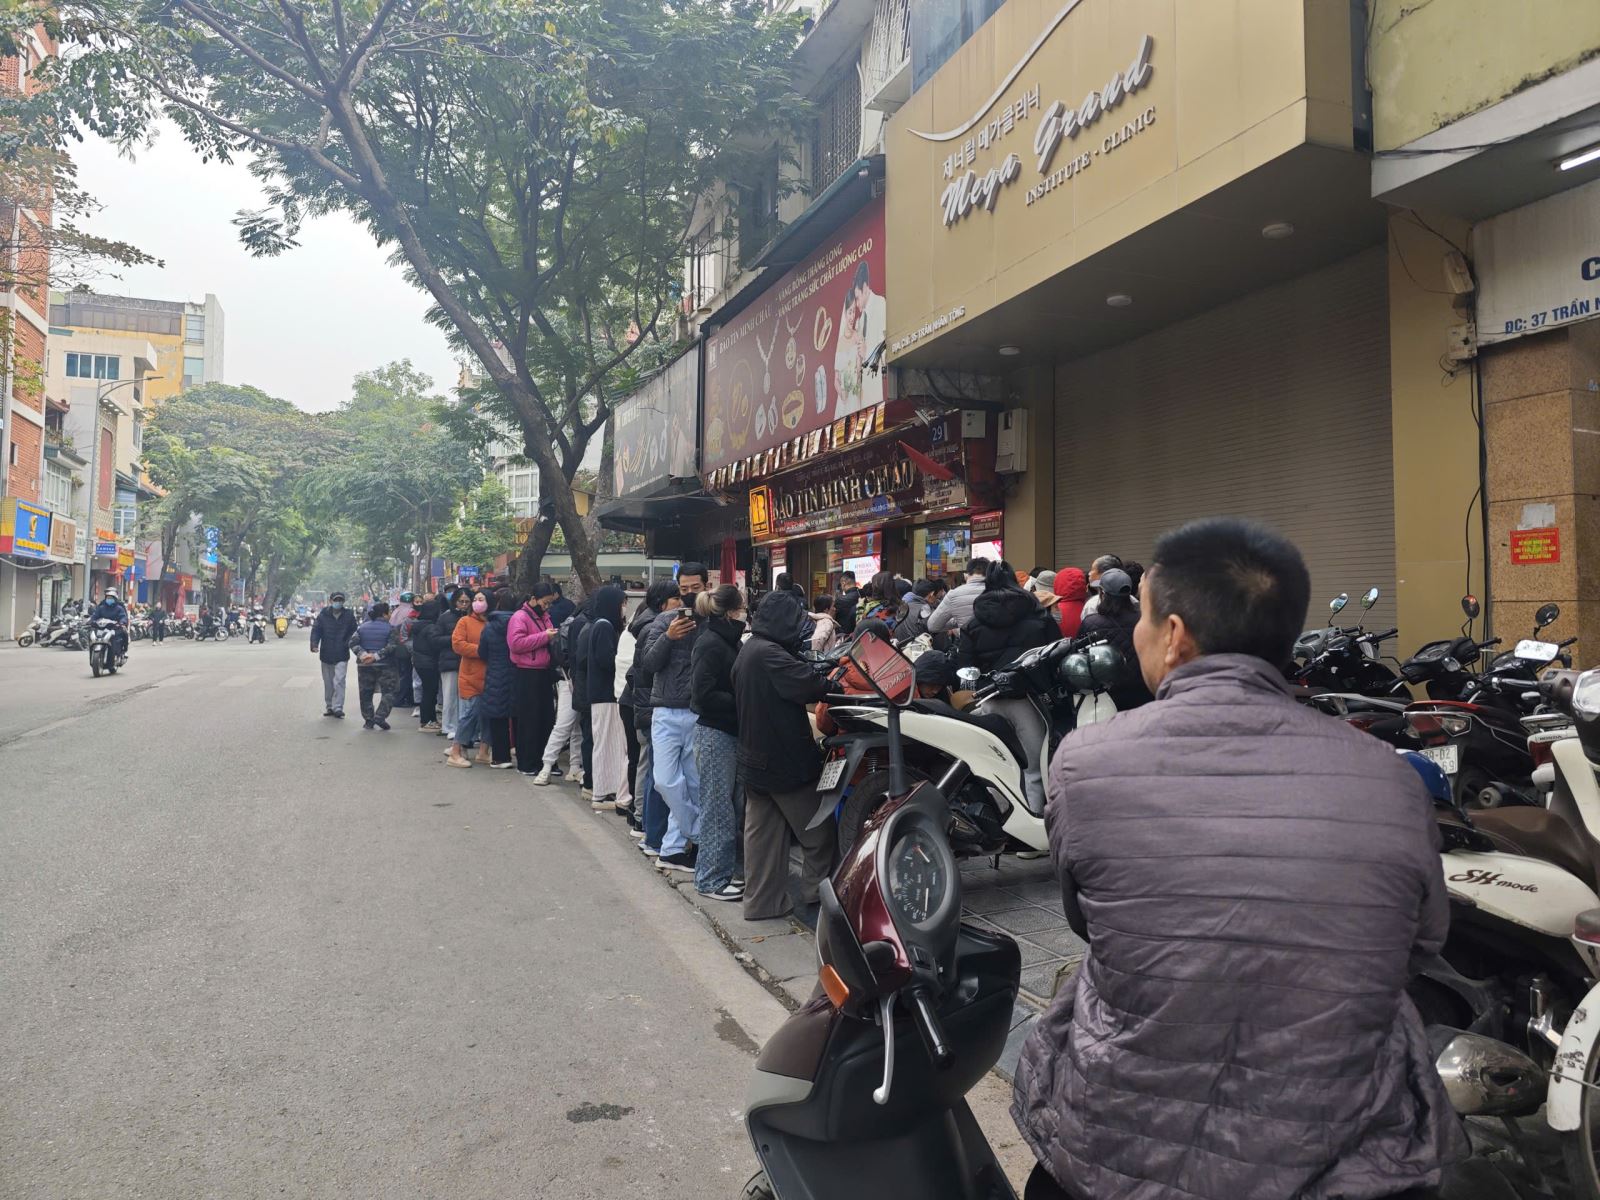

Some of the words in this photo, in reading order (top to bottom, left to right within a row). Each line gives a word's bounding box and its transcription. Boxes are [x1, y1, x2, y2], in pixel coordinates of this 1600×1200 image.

[941, 152, 1022, 228] Mega
[1033, 34, 1154, 174] Grand
[1025, 150, 1091, 206] INSTITUTE
[1101, 106, 1156, 155] CLINIC
[857, 237, 873, 258] CAO
[1505, 318, 1527, 335] ĐC:
[1531, 311, 1548, 327] 37
[1552, 298, 1590, 322] TRẦN
[932, 426, 943, 442] 29
